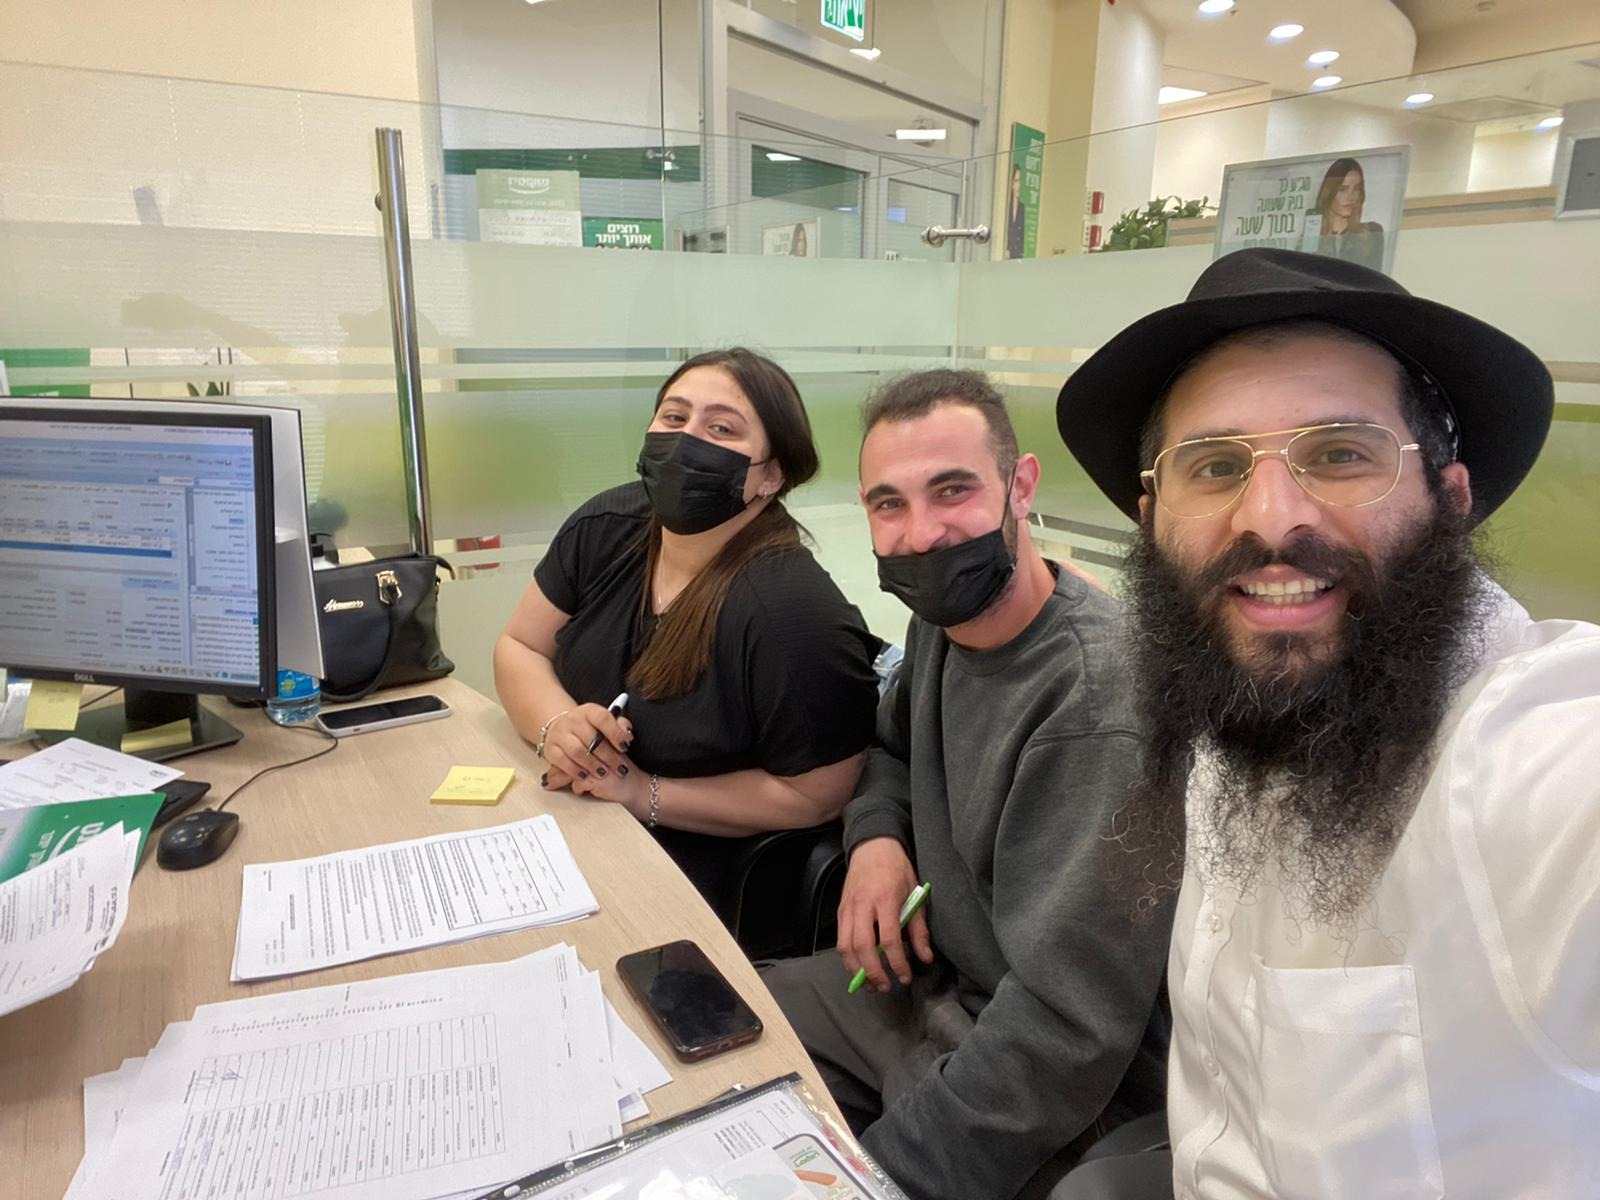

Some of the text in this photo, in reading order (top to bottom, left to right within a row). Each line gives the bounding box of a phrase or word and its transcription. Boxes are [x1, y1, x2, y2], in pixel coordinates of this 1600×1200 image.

[607, 223, 640, 234] רוצים
[1236, 213, 1295, 237] בתוך שעה
[595, 233, 652, 246] אותך יותר
[74, 672, 95, 682] DELL
